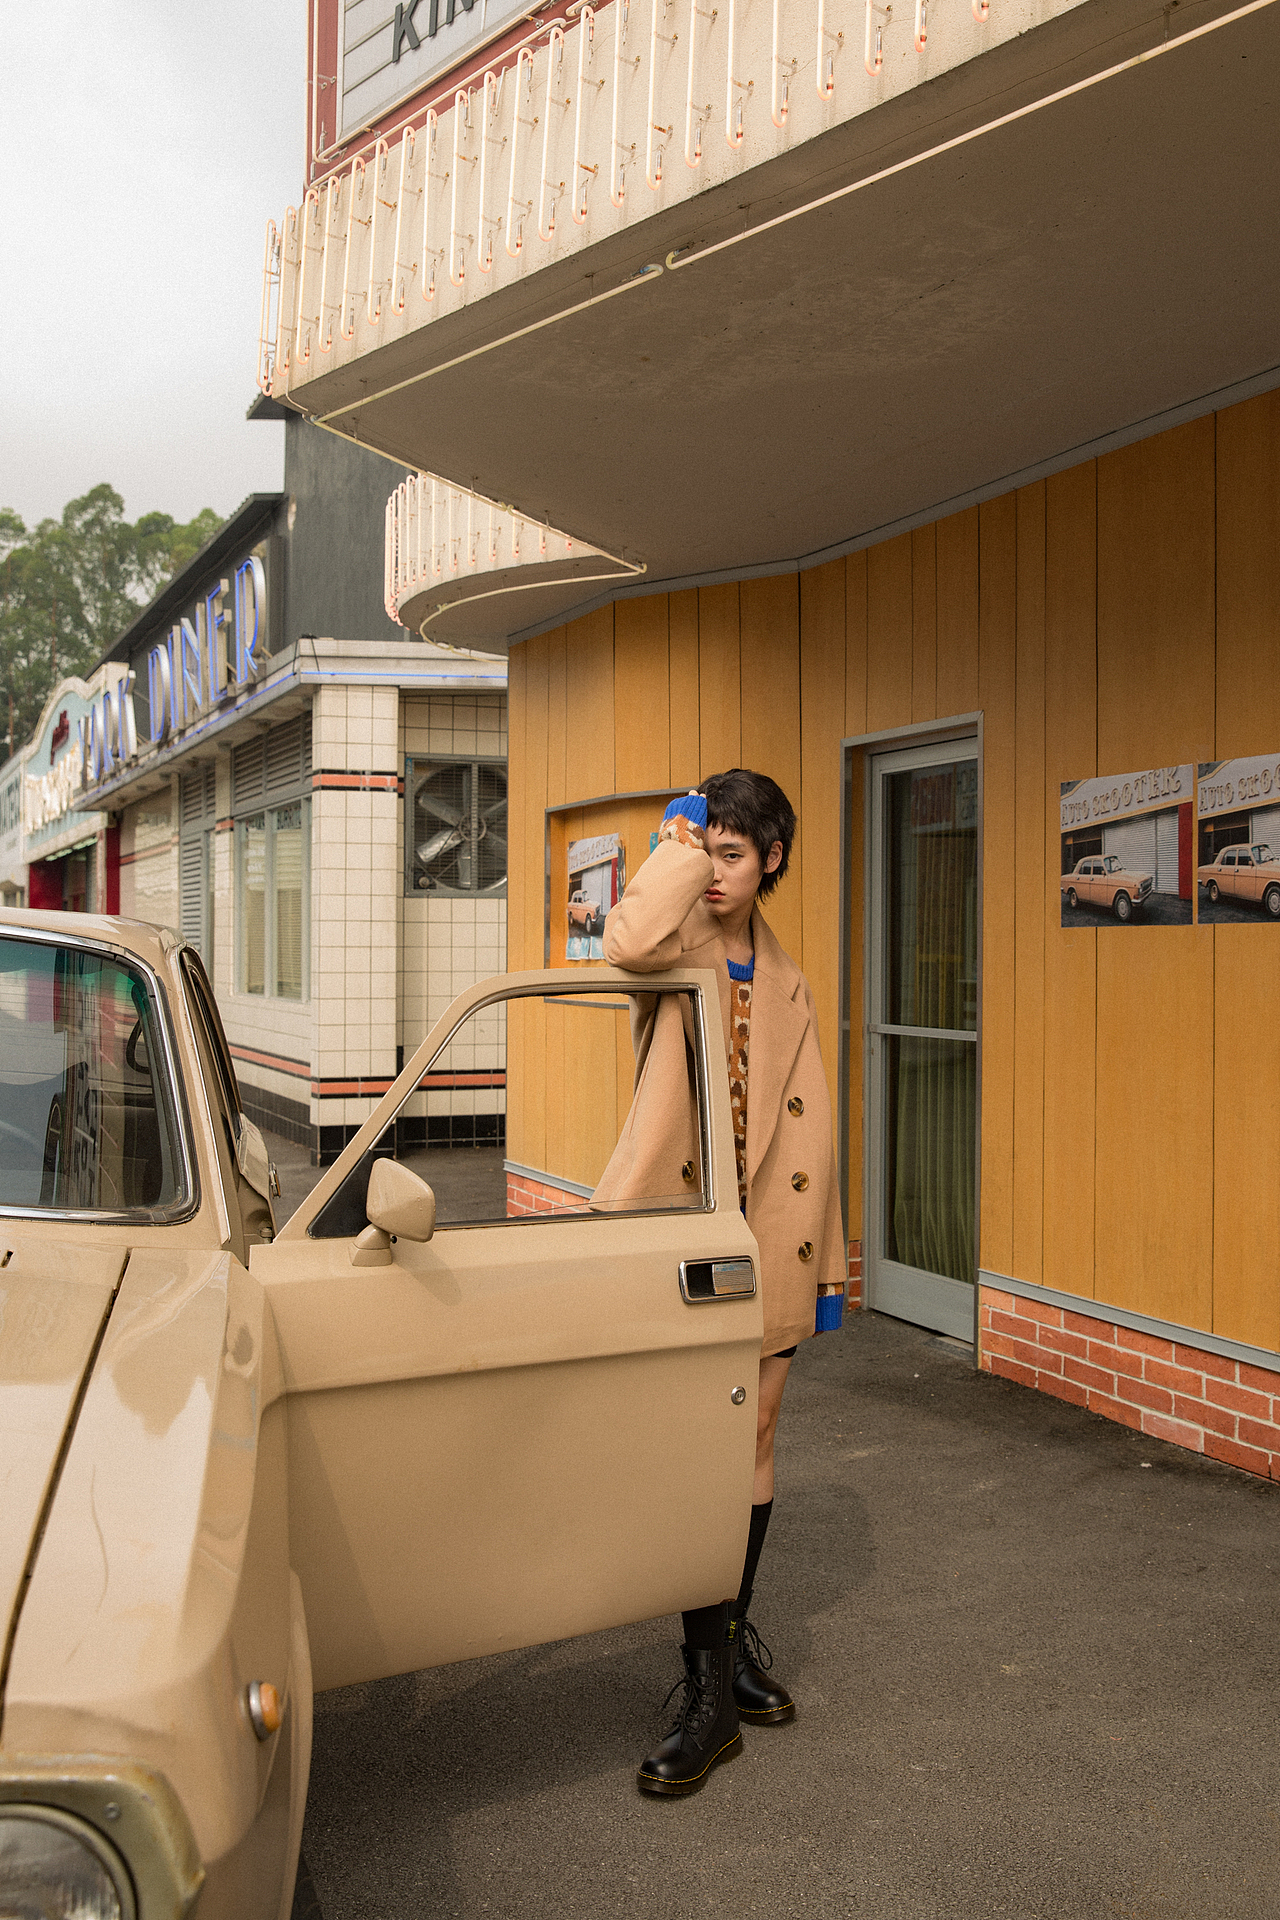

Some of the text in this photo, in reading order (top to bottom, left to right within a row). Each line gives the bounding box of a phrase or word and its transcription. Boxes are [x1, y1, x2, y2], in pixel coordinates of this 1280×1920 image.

[147, 555, 267, 744] DINER
[1061, 766, 1181, 826] AUTO SKOOTER
[1199, 782, 1234, 811] AUTO
